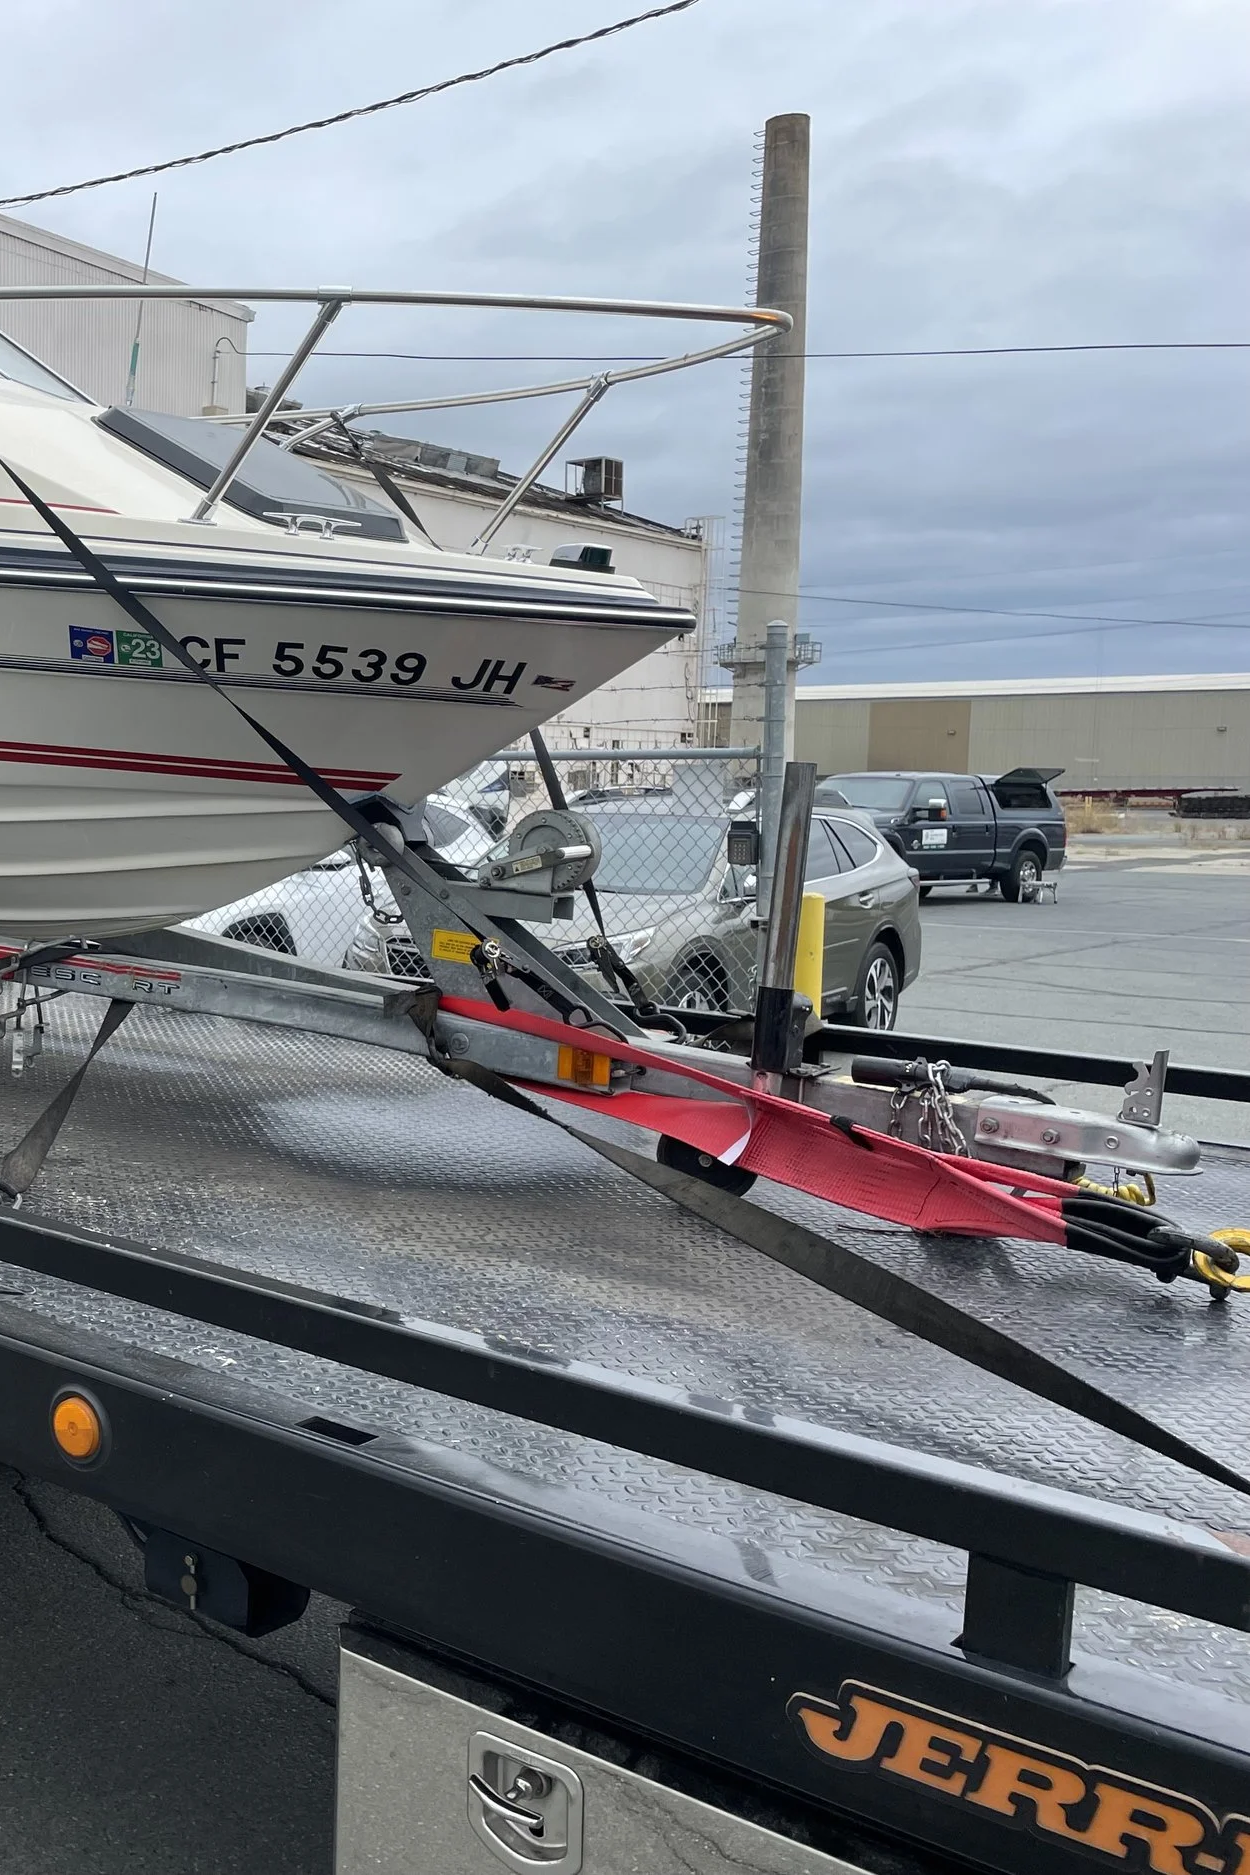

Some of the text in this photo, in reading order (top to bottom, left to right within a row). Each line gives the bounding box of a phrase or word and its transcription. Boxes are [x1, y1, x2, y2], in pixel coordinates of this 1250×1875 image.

[131, 638, 161, 660] 23
[178, 635, 528, 695] CF 5539 JH
[796, 1694, 1250, 1875] JERR-
